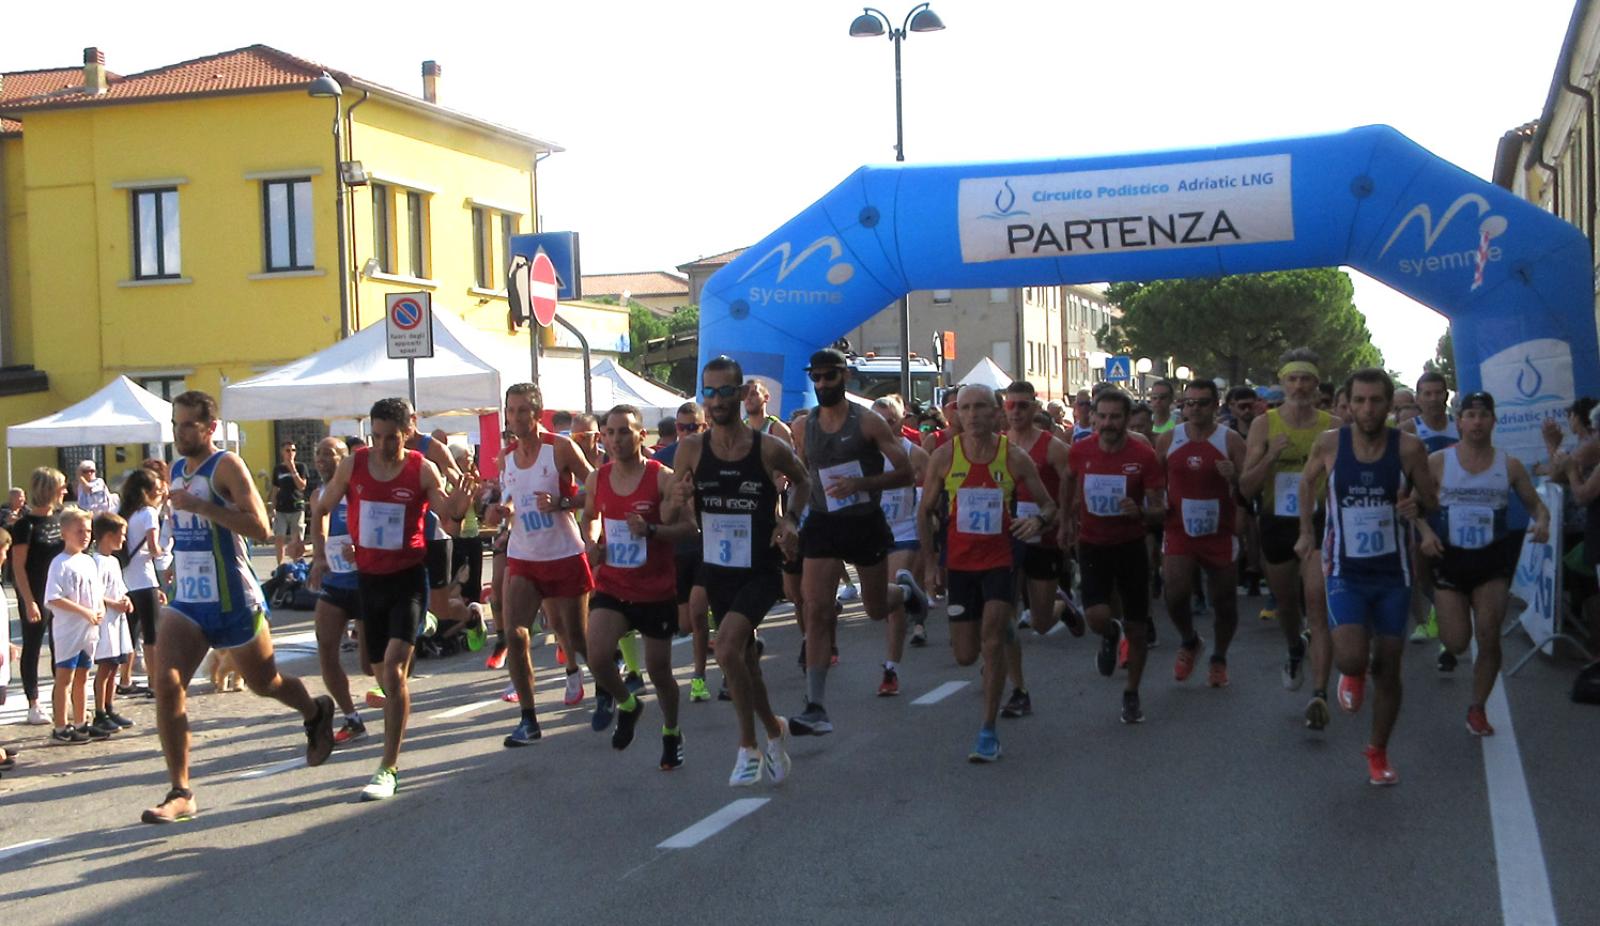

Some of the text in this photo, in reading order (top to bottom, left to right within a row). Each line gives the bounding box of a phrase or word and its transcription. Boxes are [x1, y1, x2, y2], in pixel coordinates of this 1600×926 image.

[1031, 172, 1274, 203] Circuito Podistico Adriatic LNG
[1006, 210, 1241, 255] PARTENZA
[749, 287, 844, 306] syemme
[1497, 411, 1541, 425] driatic
[1089, 495, 1121, 514] 120
[520, 510, 554, 533] 100
[969, 511, 990, 532] 21
[374, 526, 384, 547] 1
[1356, 531, 1384, 554] 20
[1457, 526, 1486, 546] 141
[607, 542, 641, 565] 122
[719, 540, 732, 563] 3
[180, 575, 211, 600] 126
